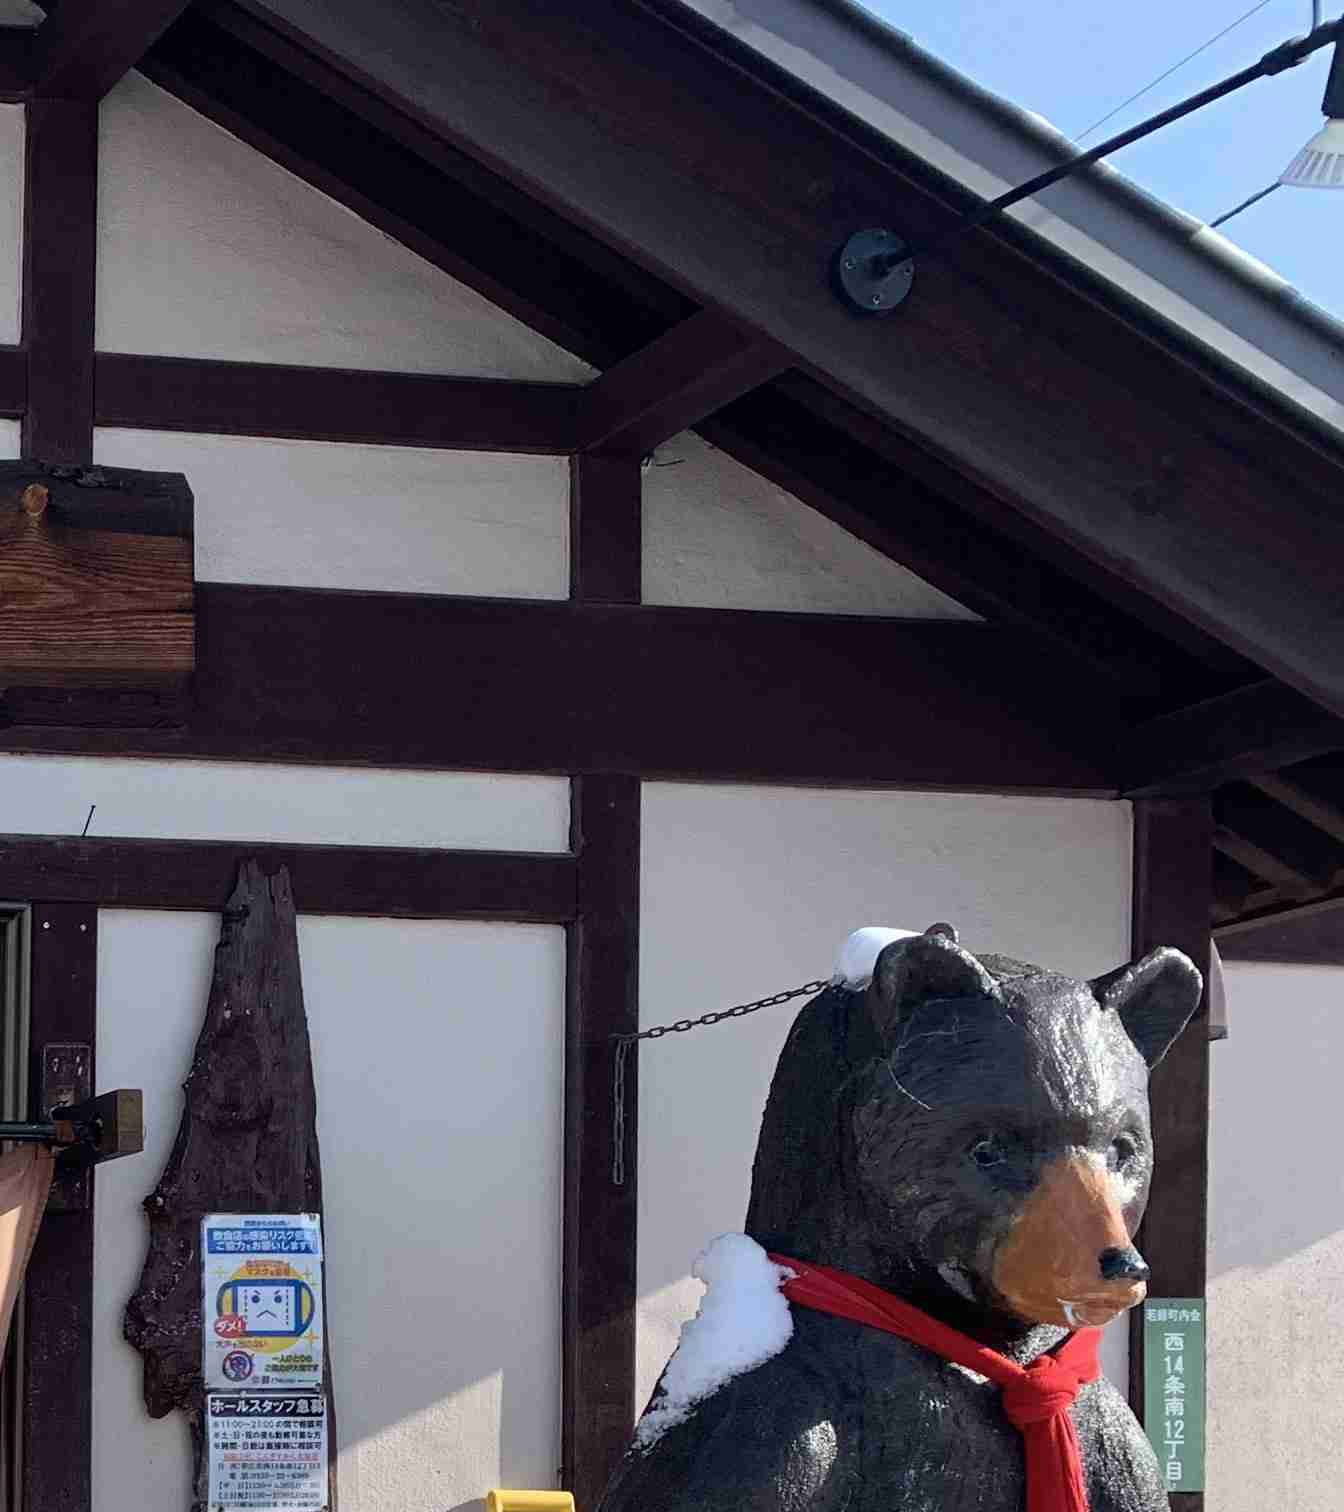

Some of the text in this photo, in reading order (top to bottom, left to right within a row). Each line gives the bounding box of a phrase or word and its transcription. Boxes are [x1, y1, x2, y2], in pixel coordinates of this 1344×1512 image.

[211, 1398, 323, 1414] ホールスタッフ急募
[1163, 1332, 1185, 1481] 西14条南12丁目
